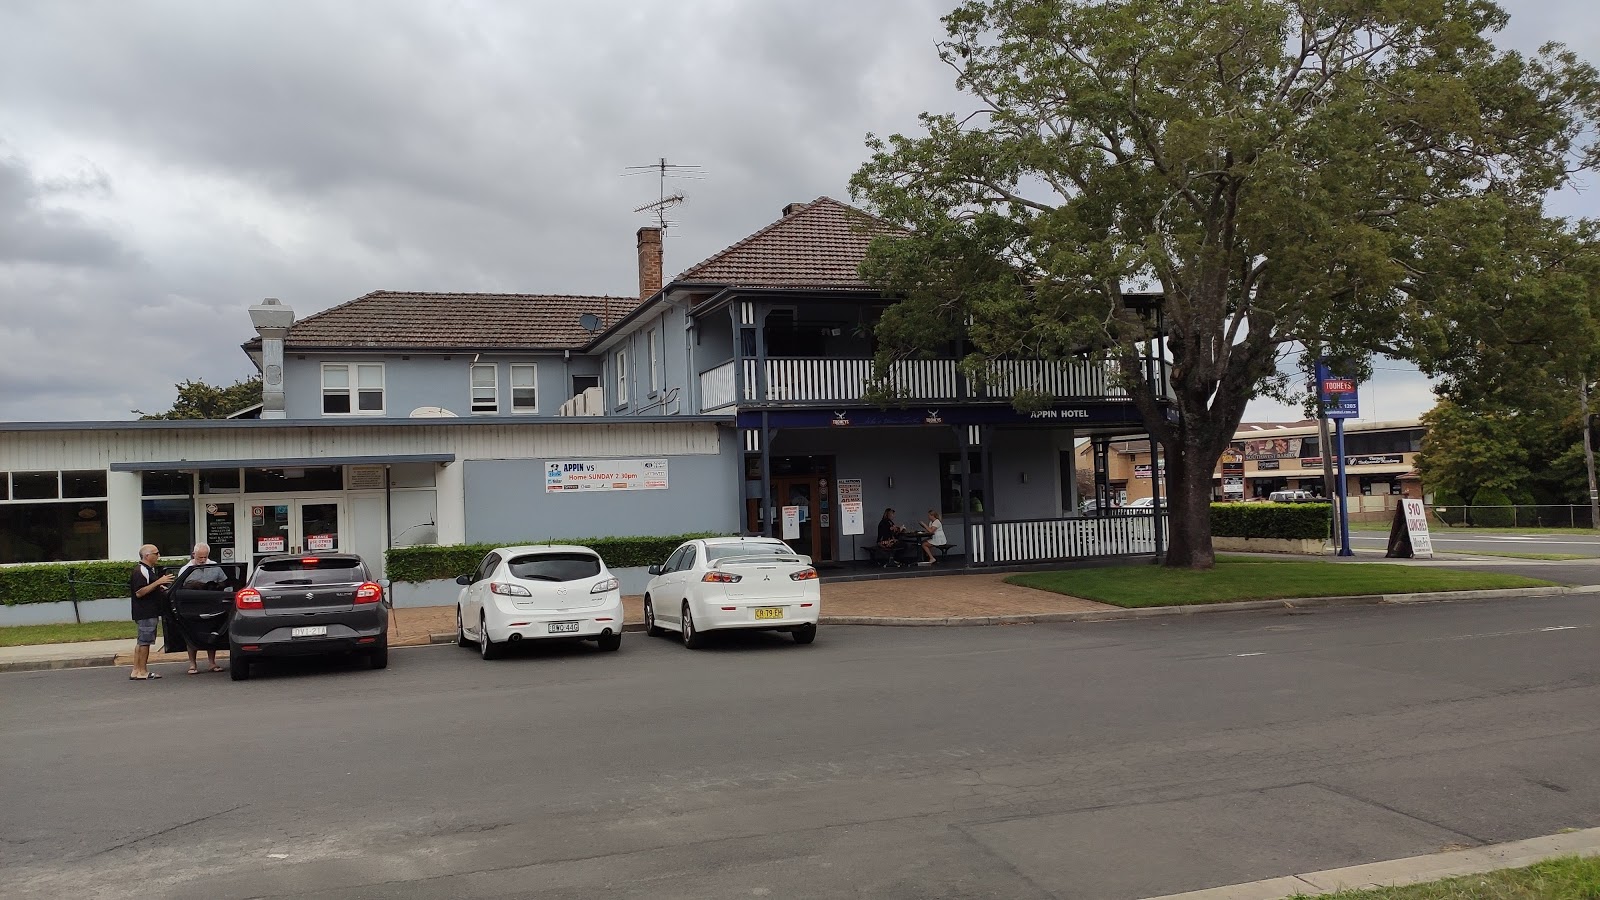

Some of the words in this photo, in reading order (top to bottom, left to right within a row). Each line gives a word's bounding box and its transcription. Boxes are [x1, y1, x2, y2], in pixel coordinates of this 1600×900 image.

[1030, 410, 1057, 418] APPIN
[564, 464, 584, 472] APPIN
[1408, 503, 1420, 516] $10
